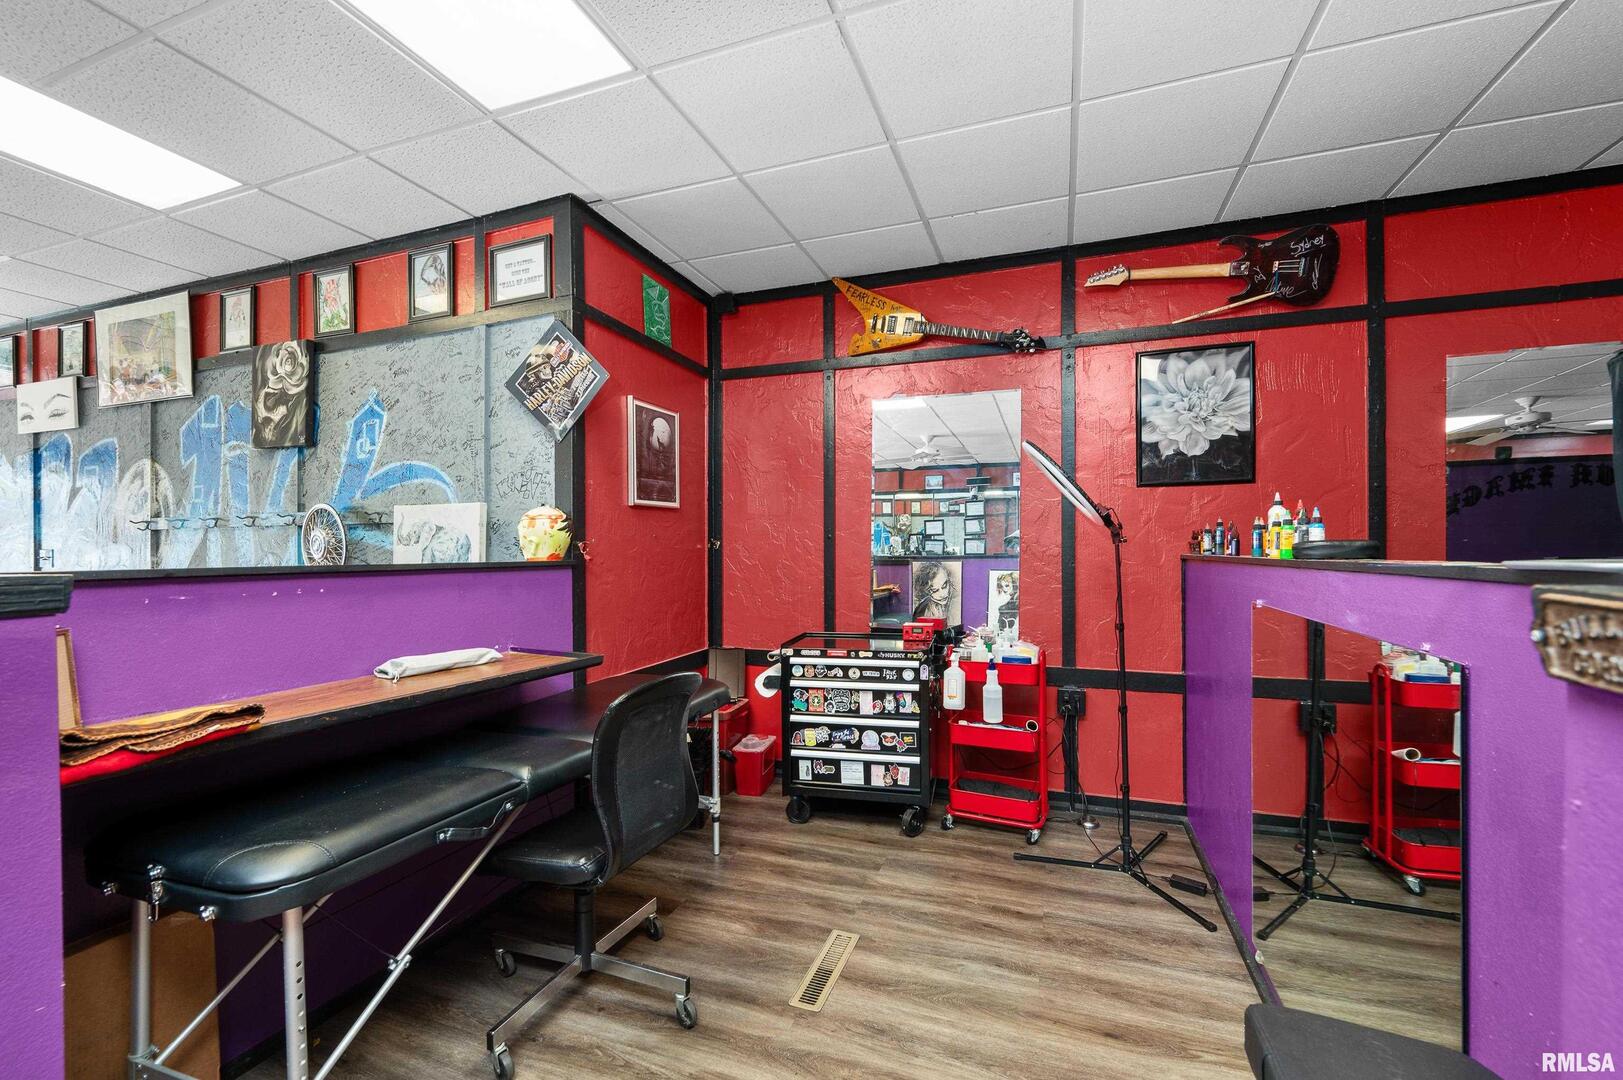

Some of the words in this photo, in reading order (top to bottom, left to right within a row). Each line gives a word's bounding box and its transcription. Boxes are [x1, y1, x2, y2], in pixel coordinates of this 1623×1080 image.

[1290, 235, 1325, 254] Sydney
[846, 285, 887, 310] FEARLESS
[523, 352, 593, 411] HARLEY-DAVIDSON
